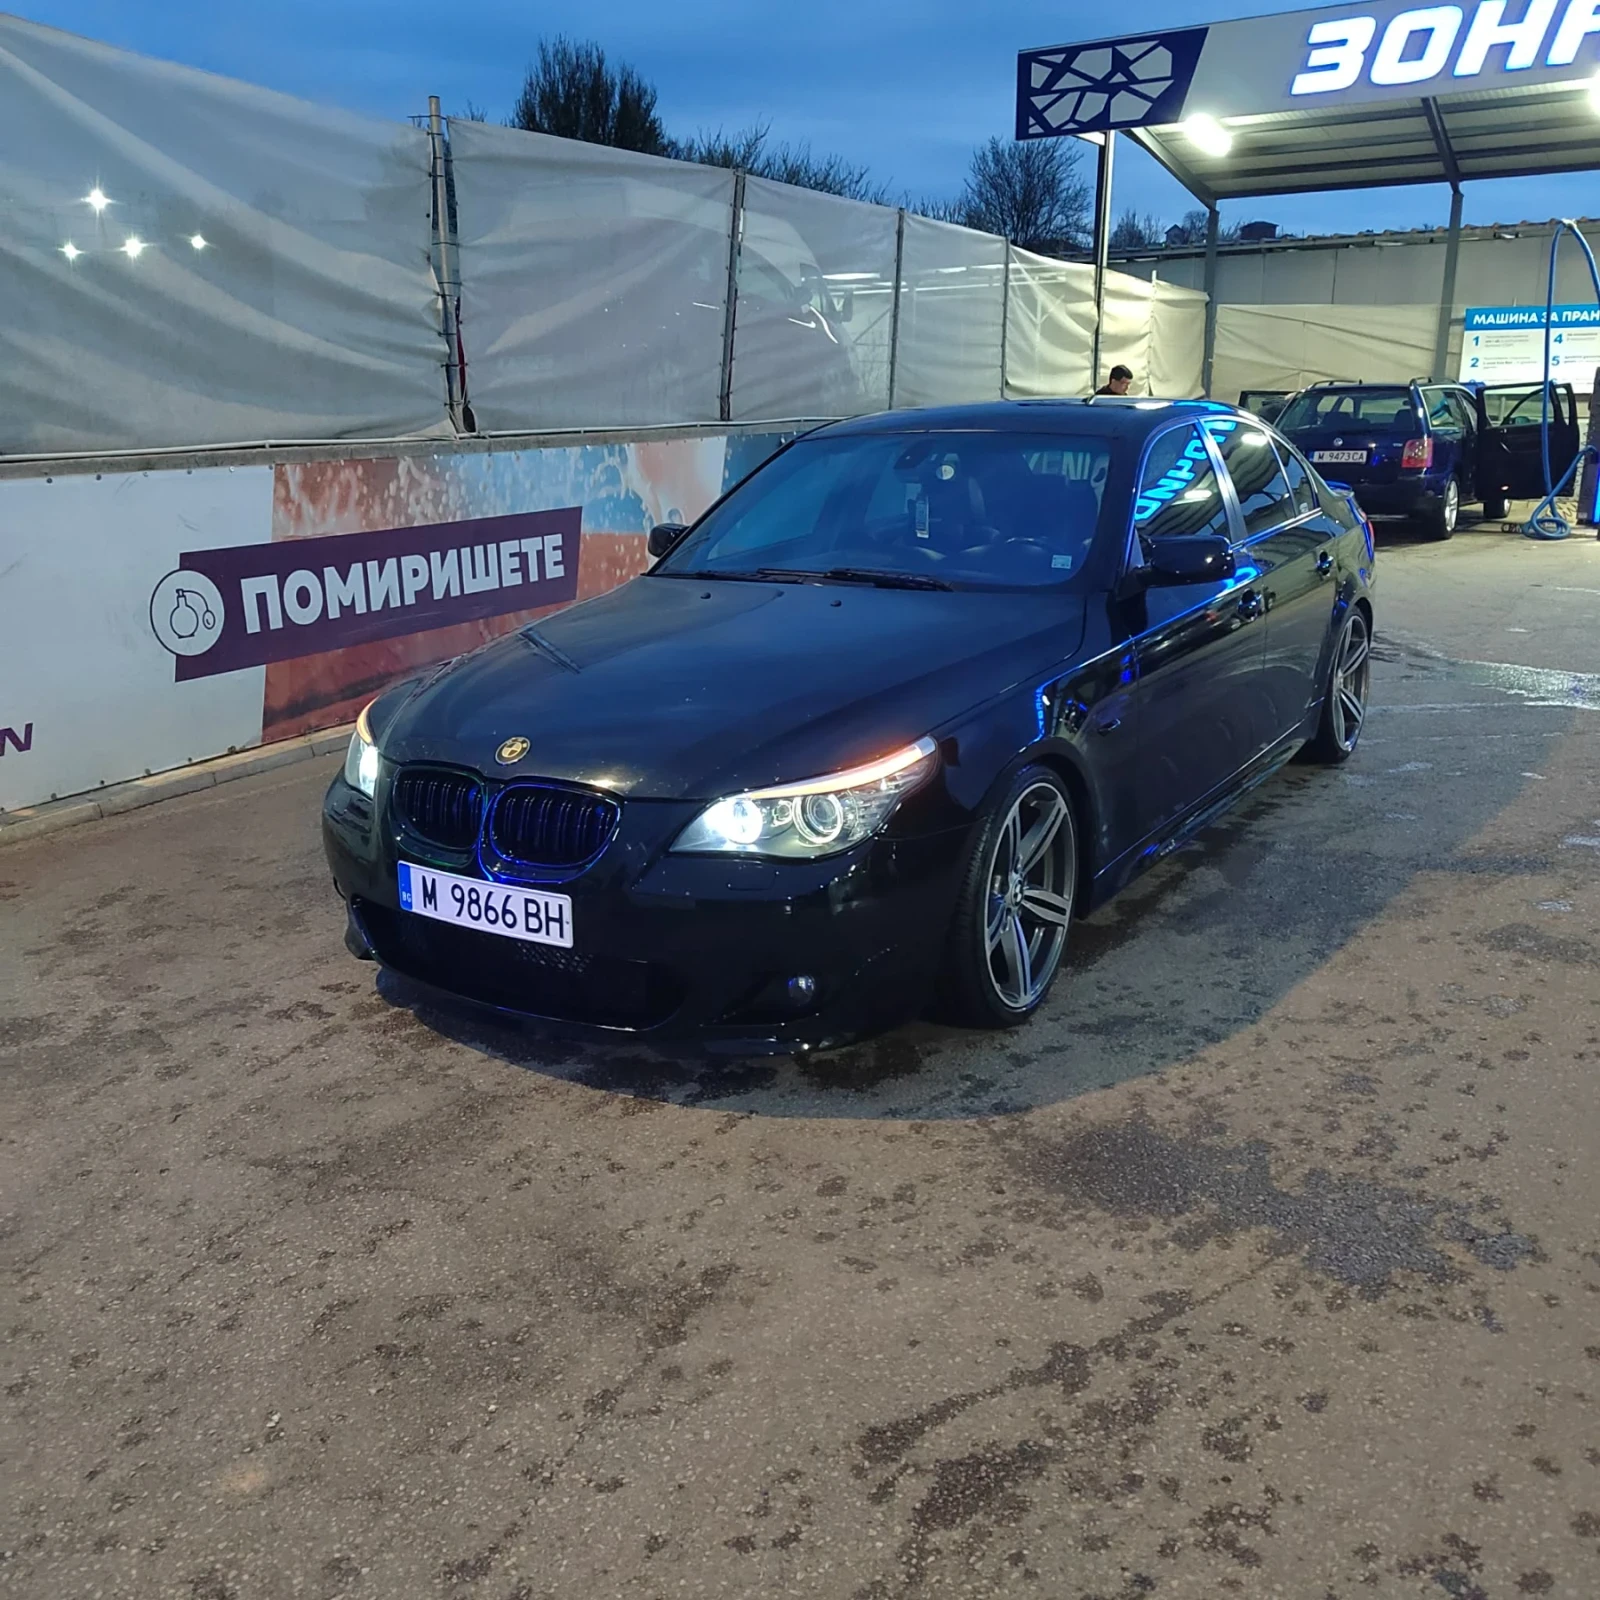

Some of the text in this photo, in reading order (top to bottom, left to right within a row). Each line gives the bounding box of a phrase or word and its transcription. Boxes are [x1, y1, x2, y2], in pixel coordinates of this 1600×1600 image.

[1473, 312, 1538, 325] МАШИНА
[1472, 336, 1480, 346] 1
[1553, 333, 1563, 344] 4
[1470, 357, 1479, 367] 2
[1551, 355, 1560, 366] 5
[240, 532, 566, 634] ПОМИРИШЕТЕ
[401, 891, 412, 903] BG
[421, 875, 438, 912] M
[451, 883, 517, 929] 9866
